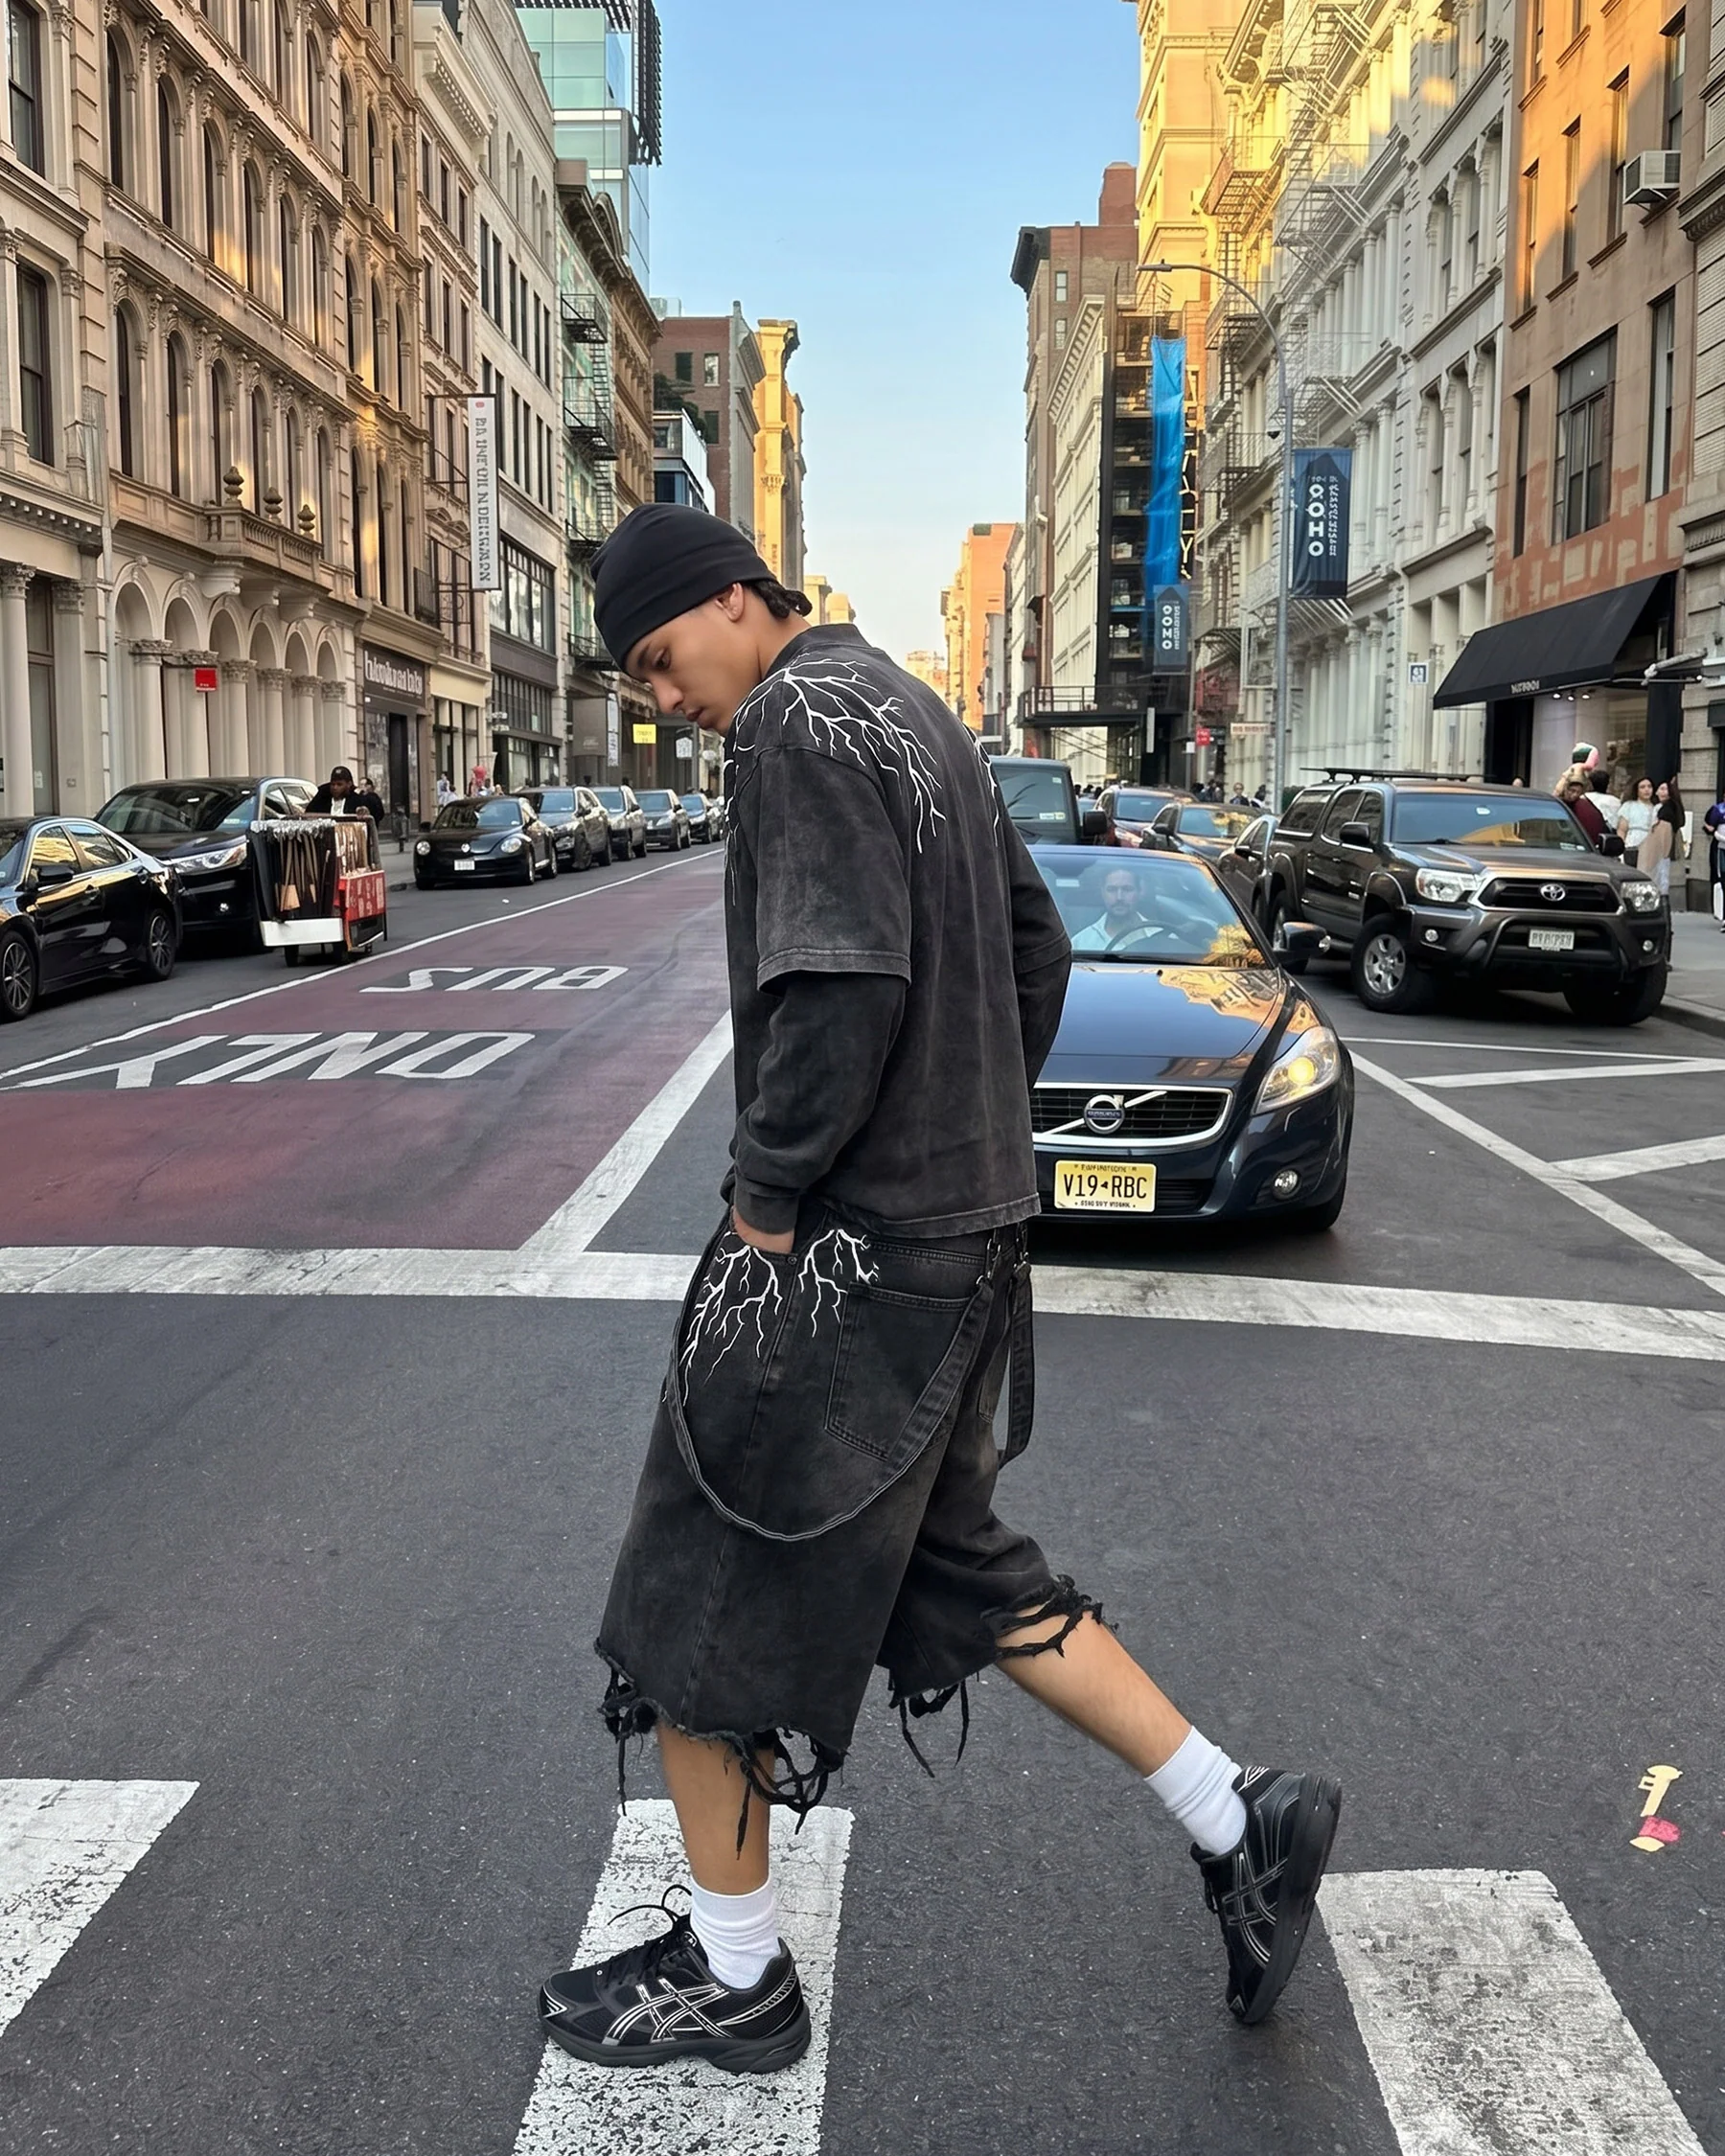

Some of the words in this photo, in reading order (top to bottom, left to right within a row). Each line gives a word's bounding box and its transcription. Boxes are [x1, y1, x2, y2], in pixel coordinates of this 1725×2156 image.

[358, 965, 630, 994] BUS
[0, 1031, 536, 1089] ONLY
[1064, 1174, 1098, 1197] V19
[1111, 1175, 1147, 1199] RBC
